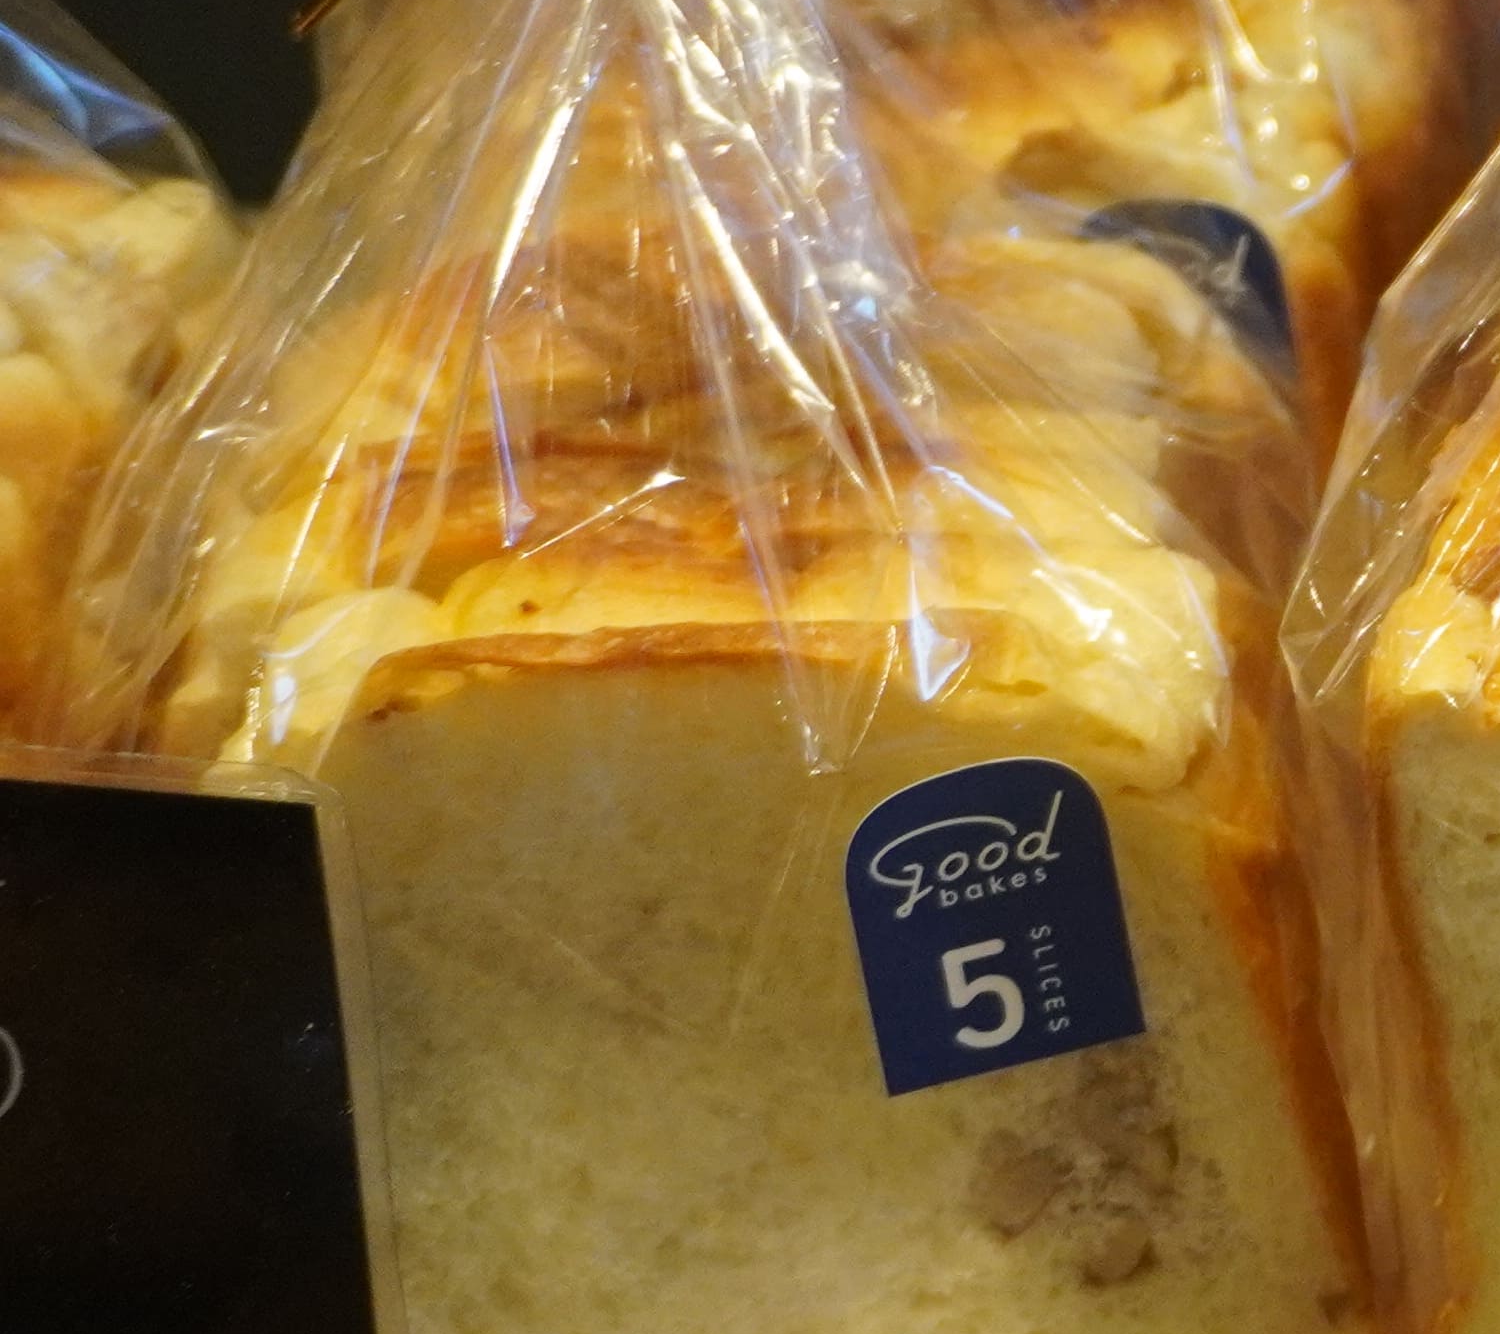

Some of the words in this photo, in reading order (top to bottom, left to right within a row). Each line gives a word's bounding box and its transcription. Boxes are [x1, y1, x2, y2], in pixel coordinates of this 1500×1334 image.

[939, 866, 1049, 908] bakes
[941, 938, 1025, 1049] 5
[1029, 924, 1070, 1032] SLICES
